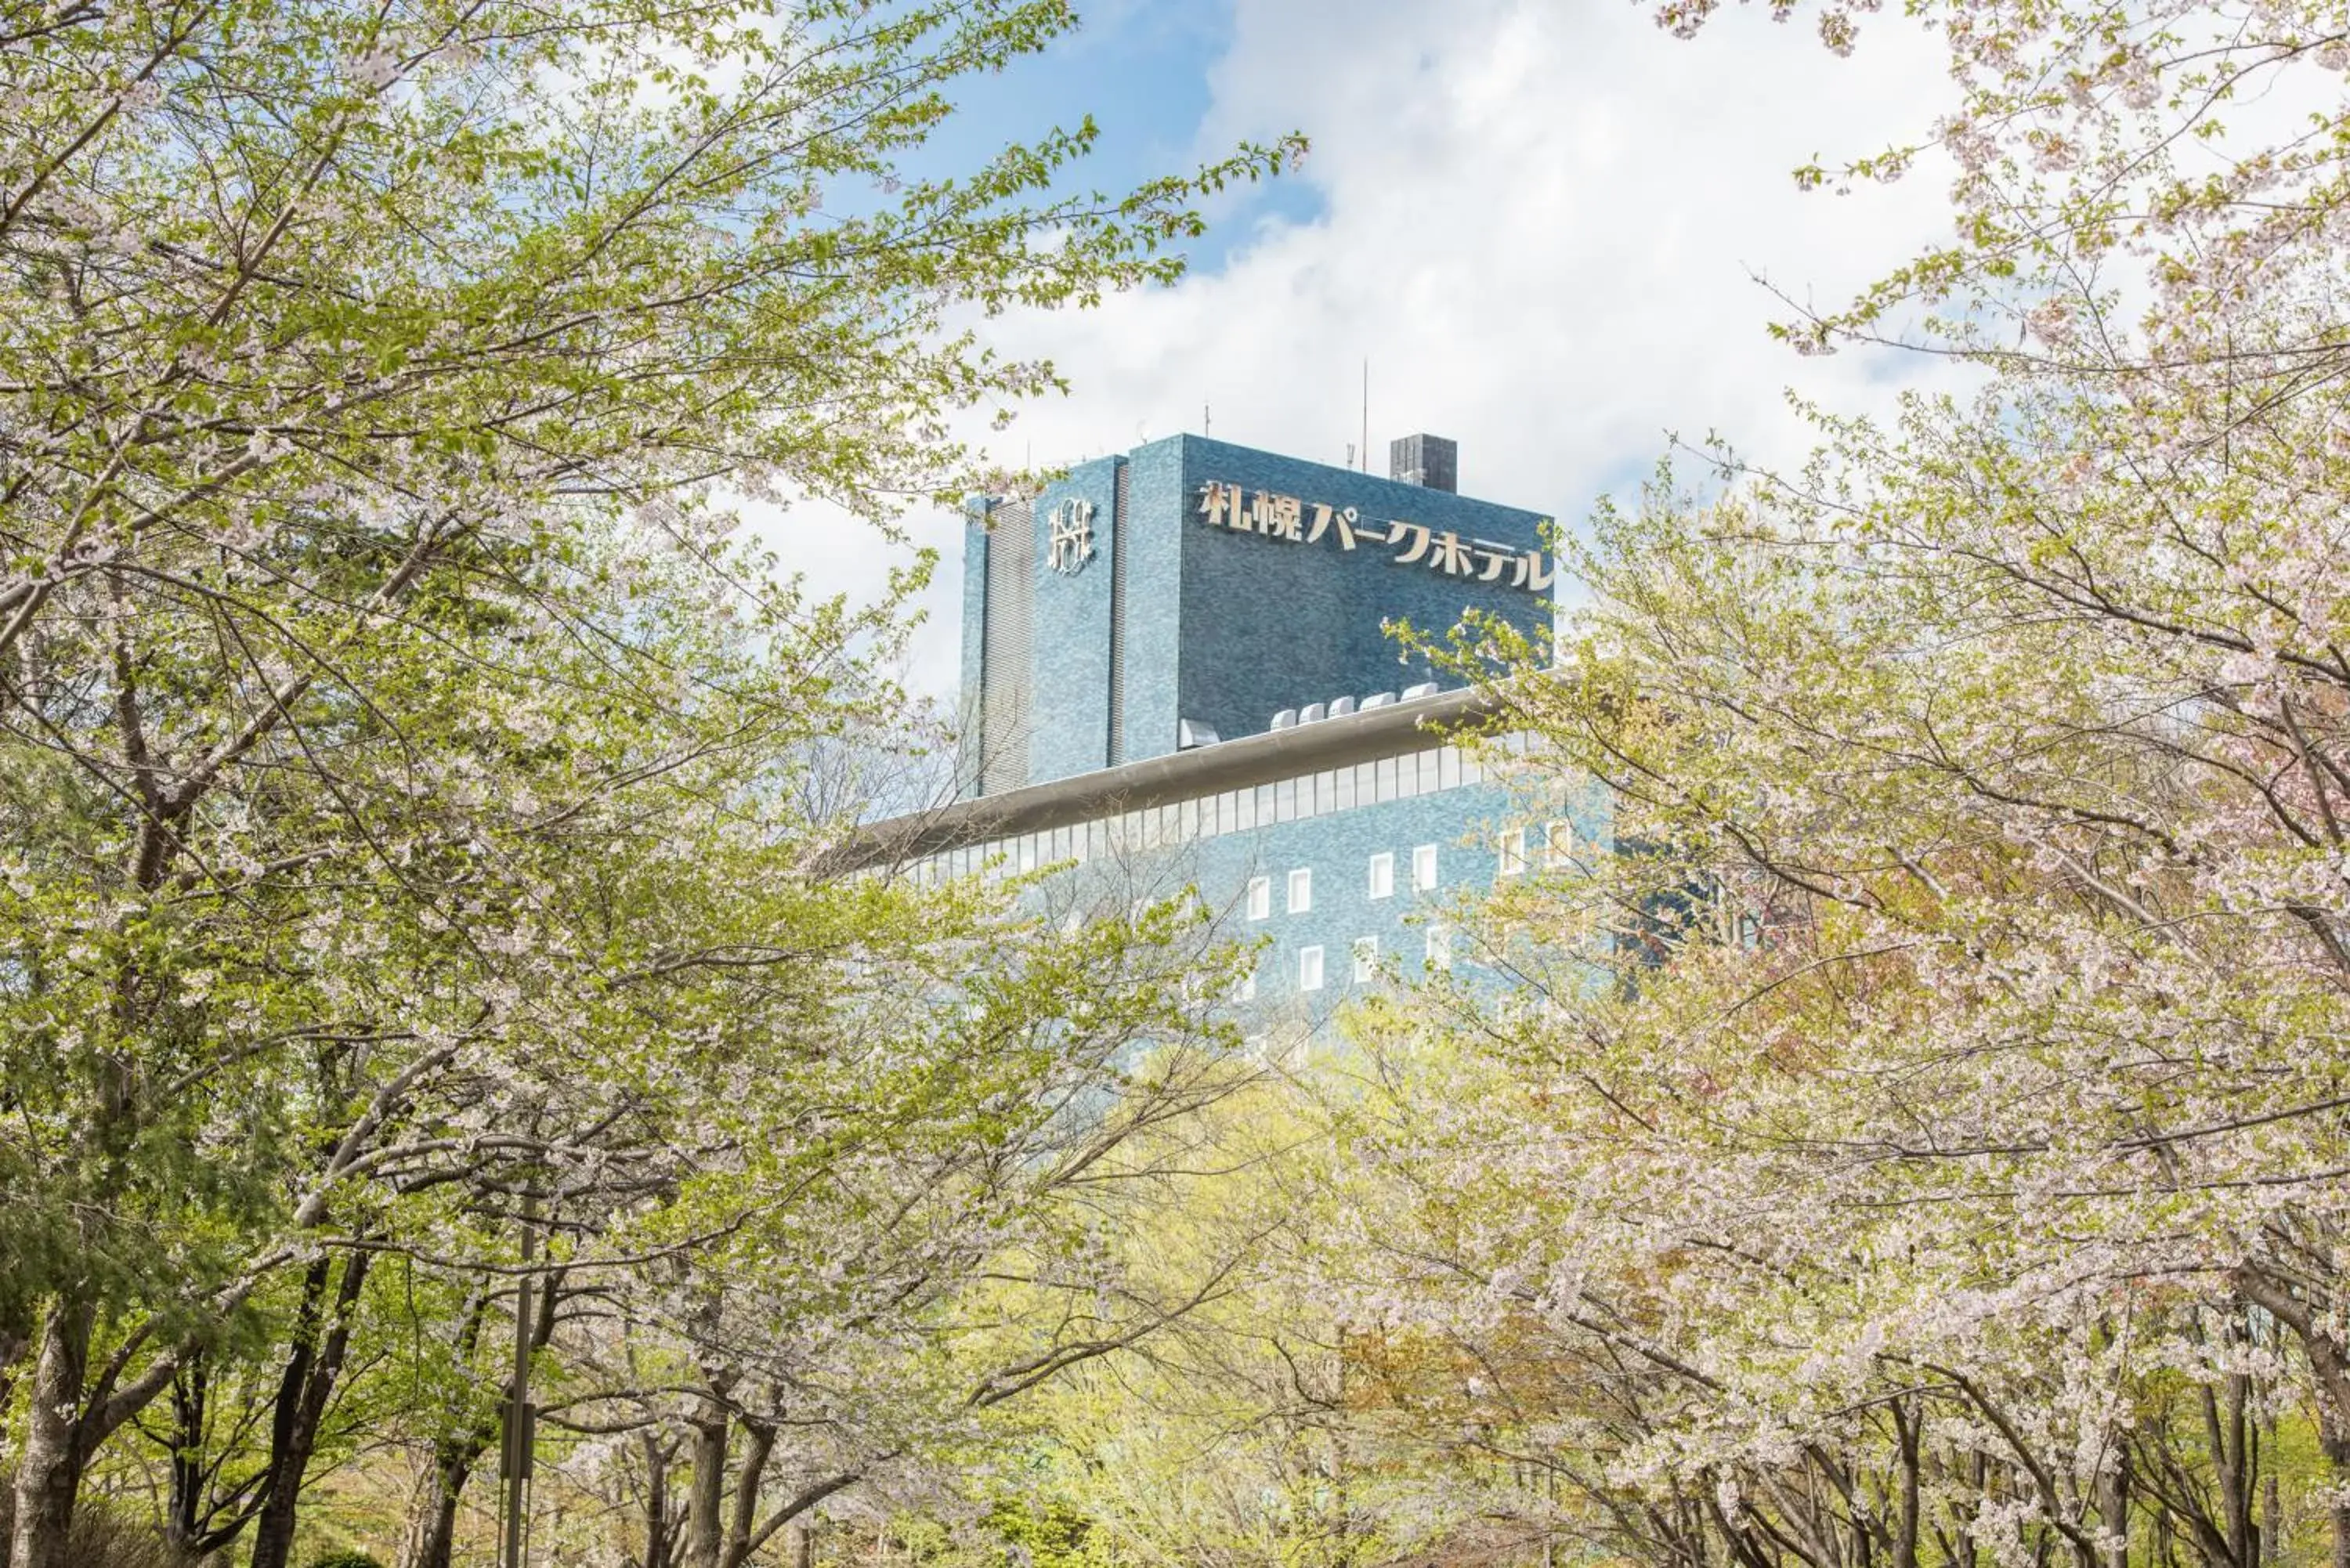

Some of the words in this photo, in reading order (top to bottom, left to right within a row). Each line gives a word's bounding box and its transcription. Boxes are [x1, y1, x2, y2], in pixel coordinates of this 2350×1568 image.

[1199, 479, 1555, 591] 札幌パークホテル
